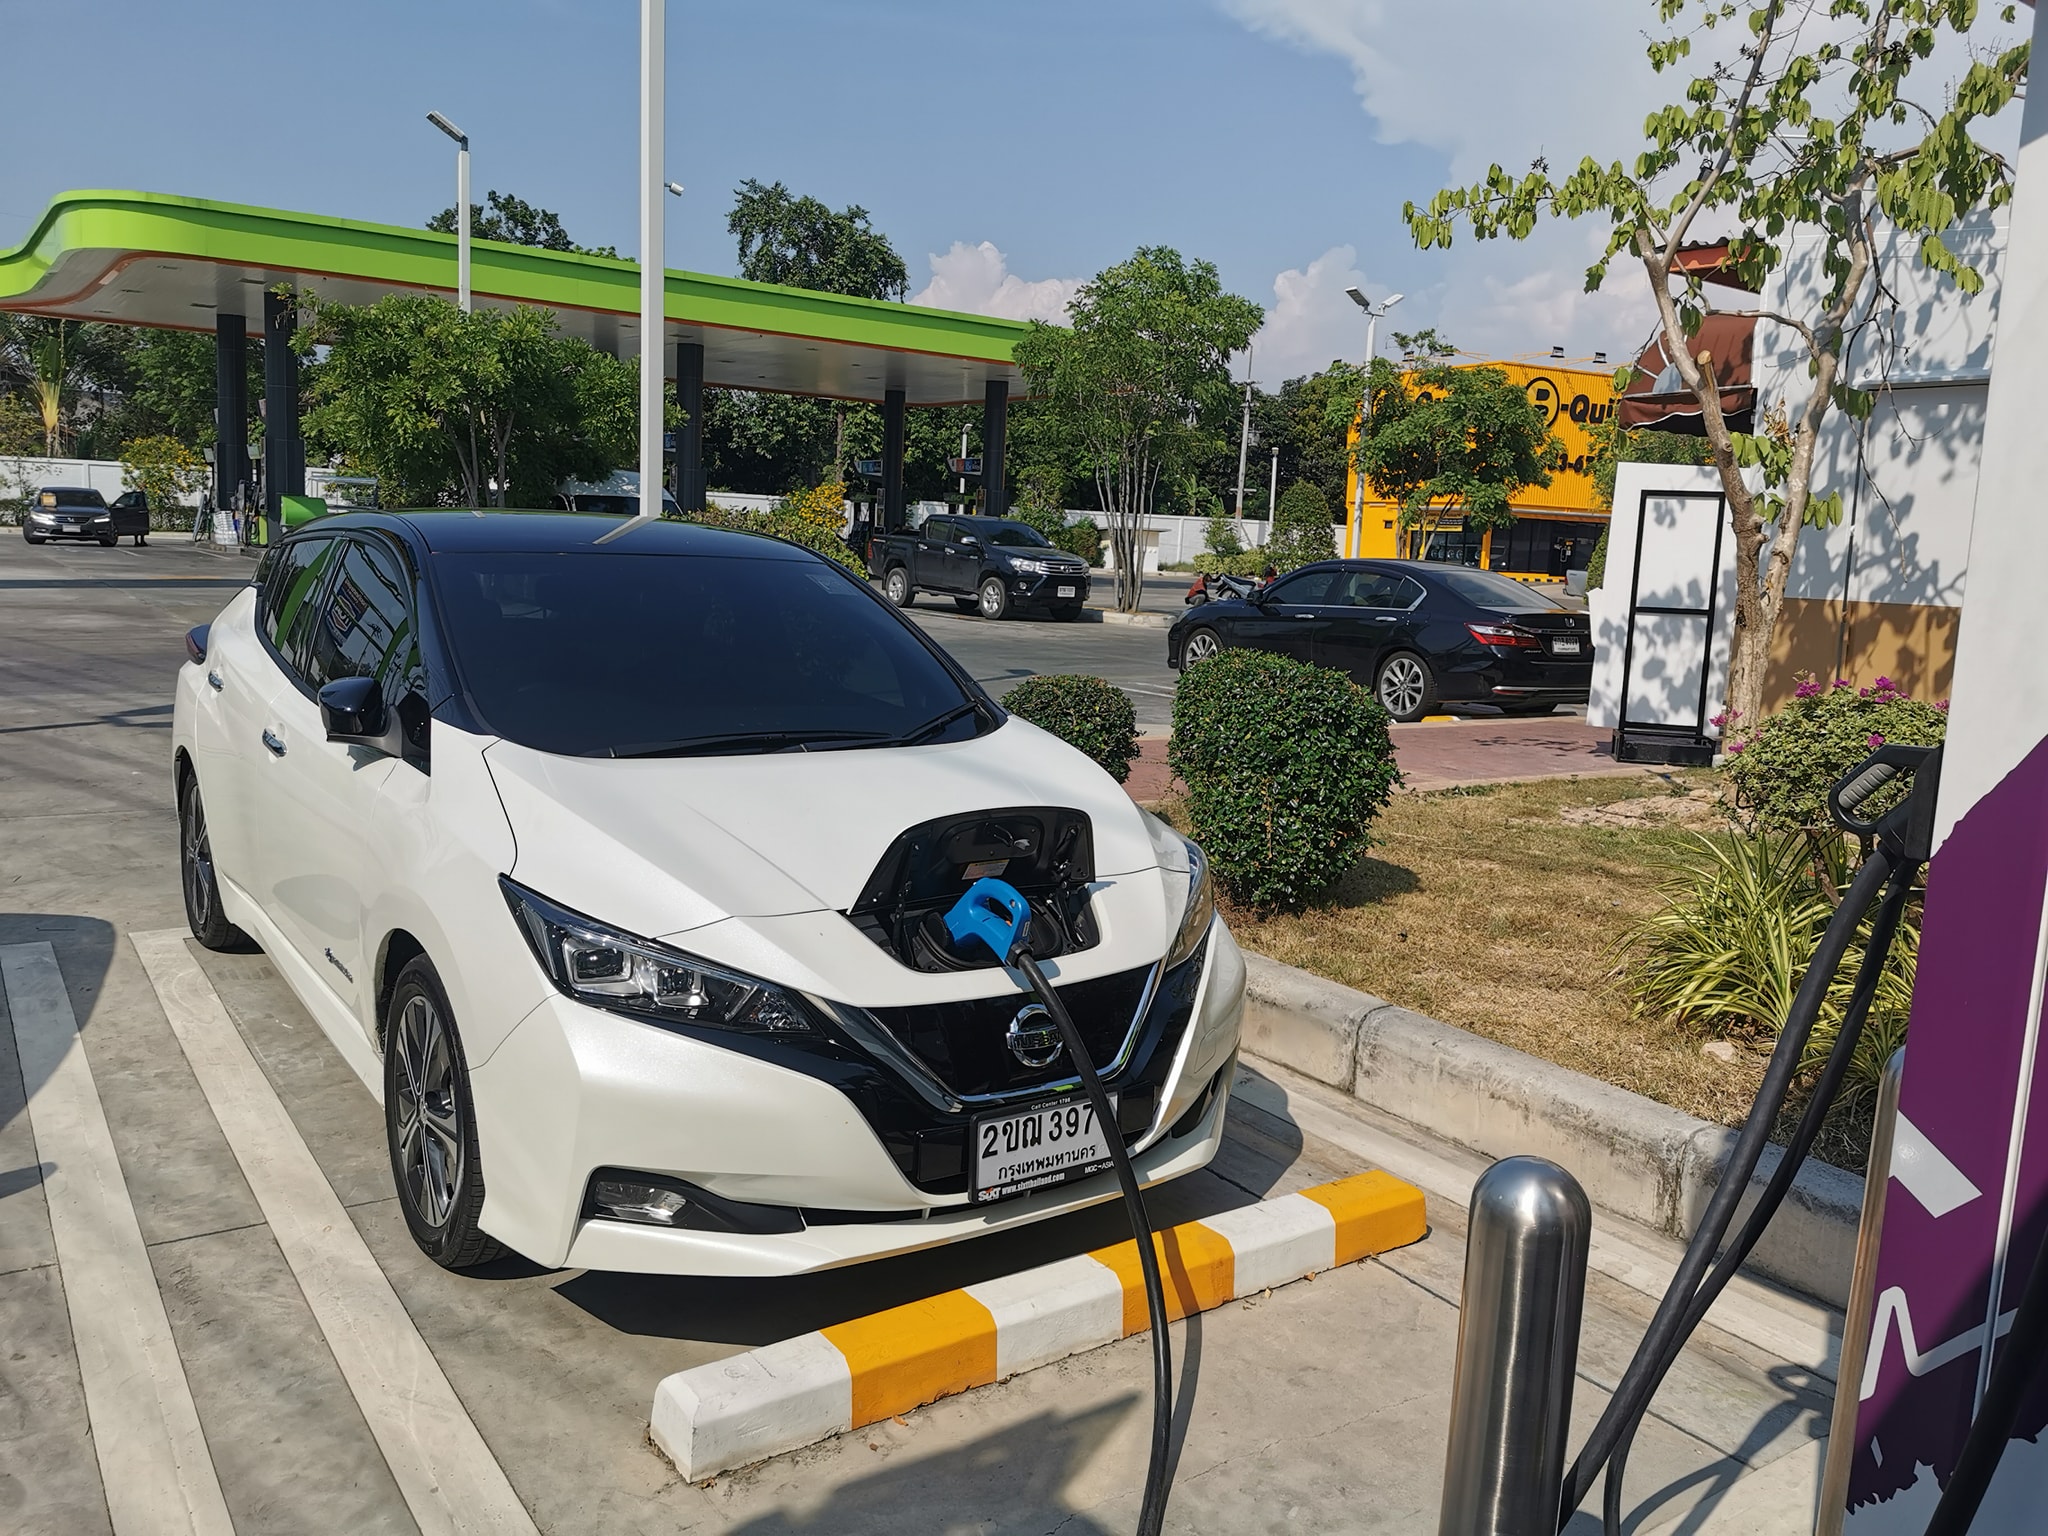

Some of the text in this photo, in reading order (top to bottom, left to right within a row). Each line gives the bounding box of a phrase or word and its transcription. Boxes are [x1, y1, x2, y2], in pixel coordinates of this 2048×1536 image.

[1528, 382, 1621, 425] B-Qui
[1030, 1103, 1042, 1111] Call
[1041, 1100, 1058, 1109] Center
[1048, 1103, 1095, 1142] 397
[998, 1144, 1096, 1182] กรุงเทพมหานคร
